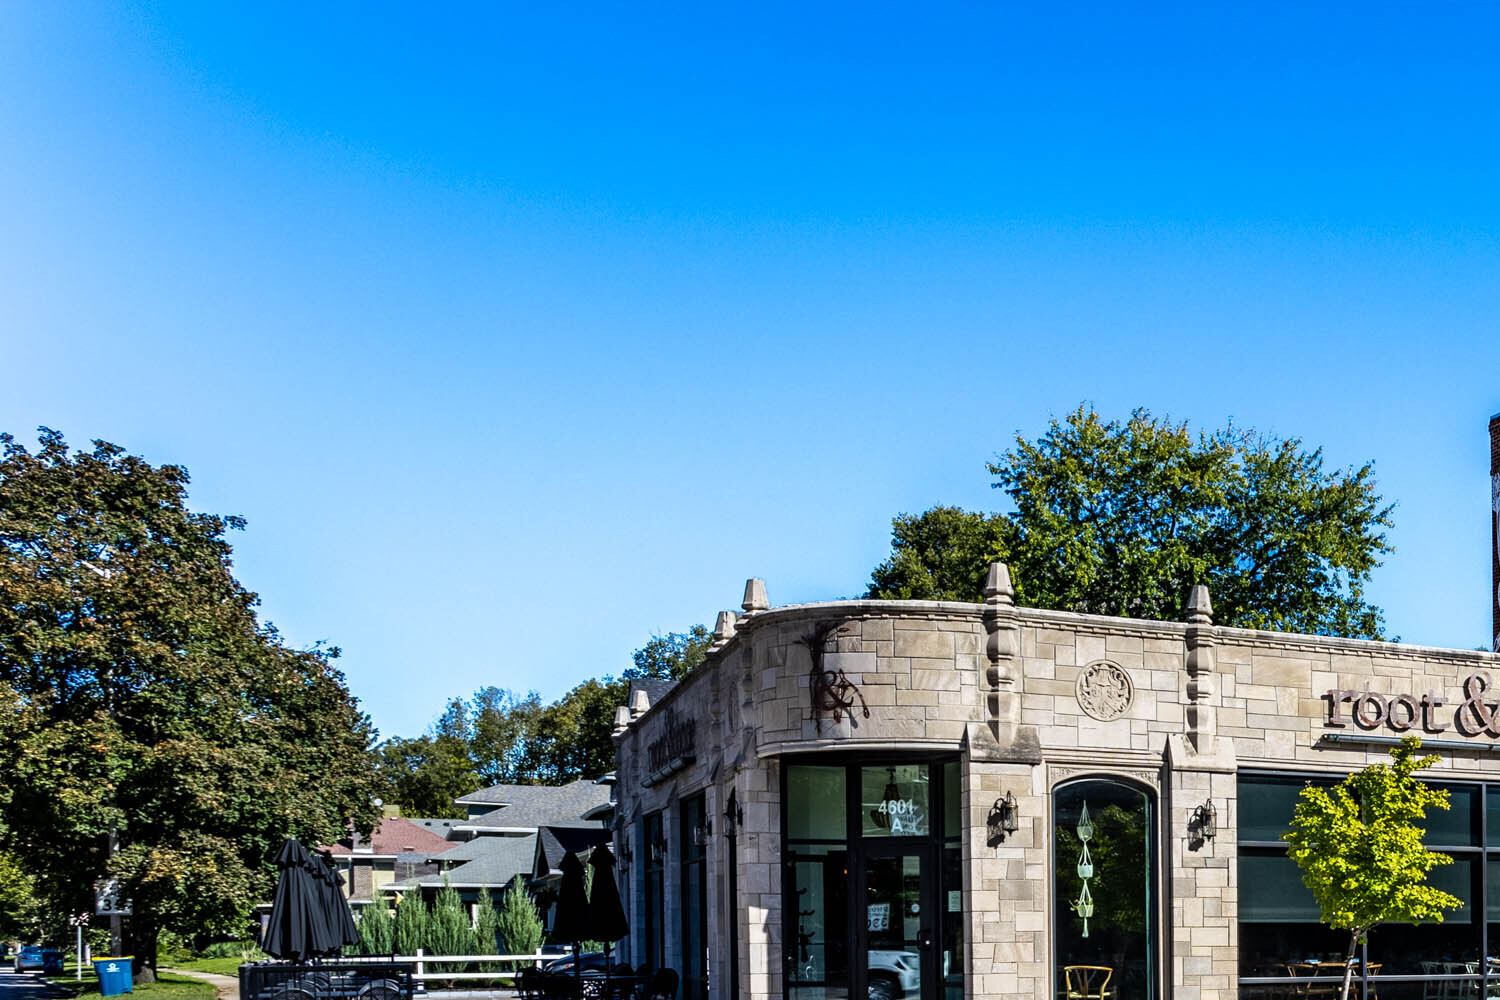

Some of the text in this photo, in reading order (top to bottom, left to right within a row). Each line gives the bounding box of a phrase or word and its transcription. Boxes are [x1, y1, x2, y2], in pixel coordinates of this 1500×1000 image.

[1323, 688, 1450, 731] root
[878, 799, 913, 815] 4601
[891, 818, 903, 832] A
